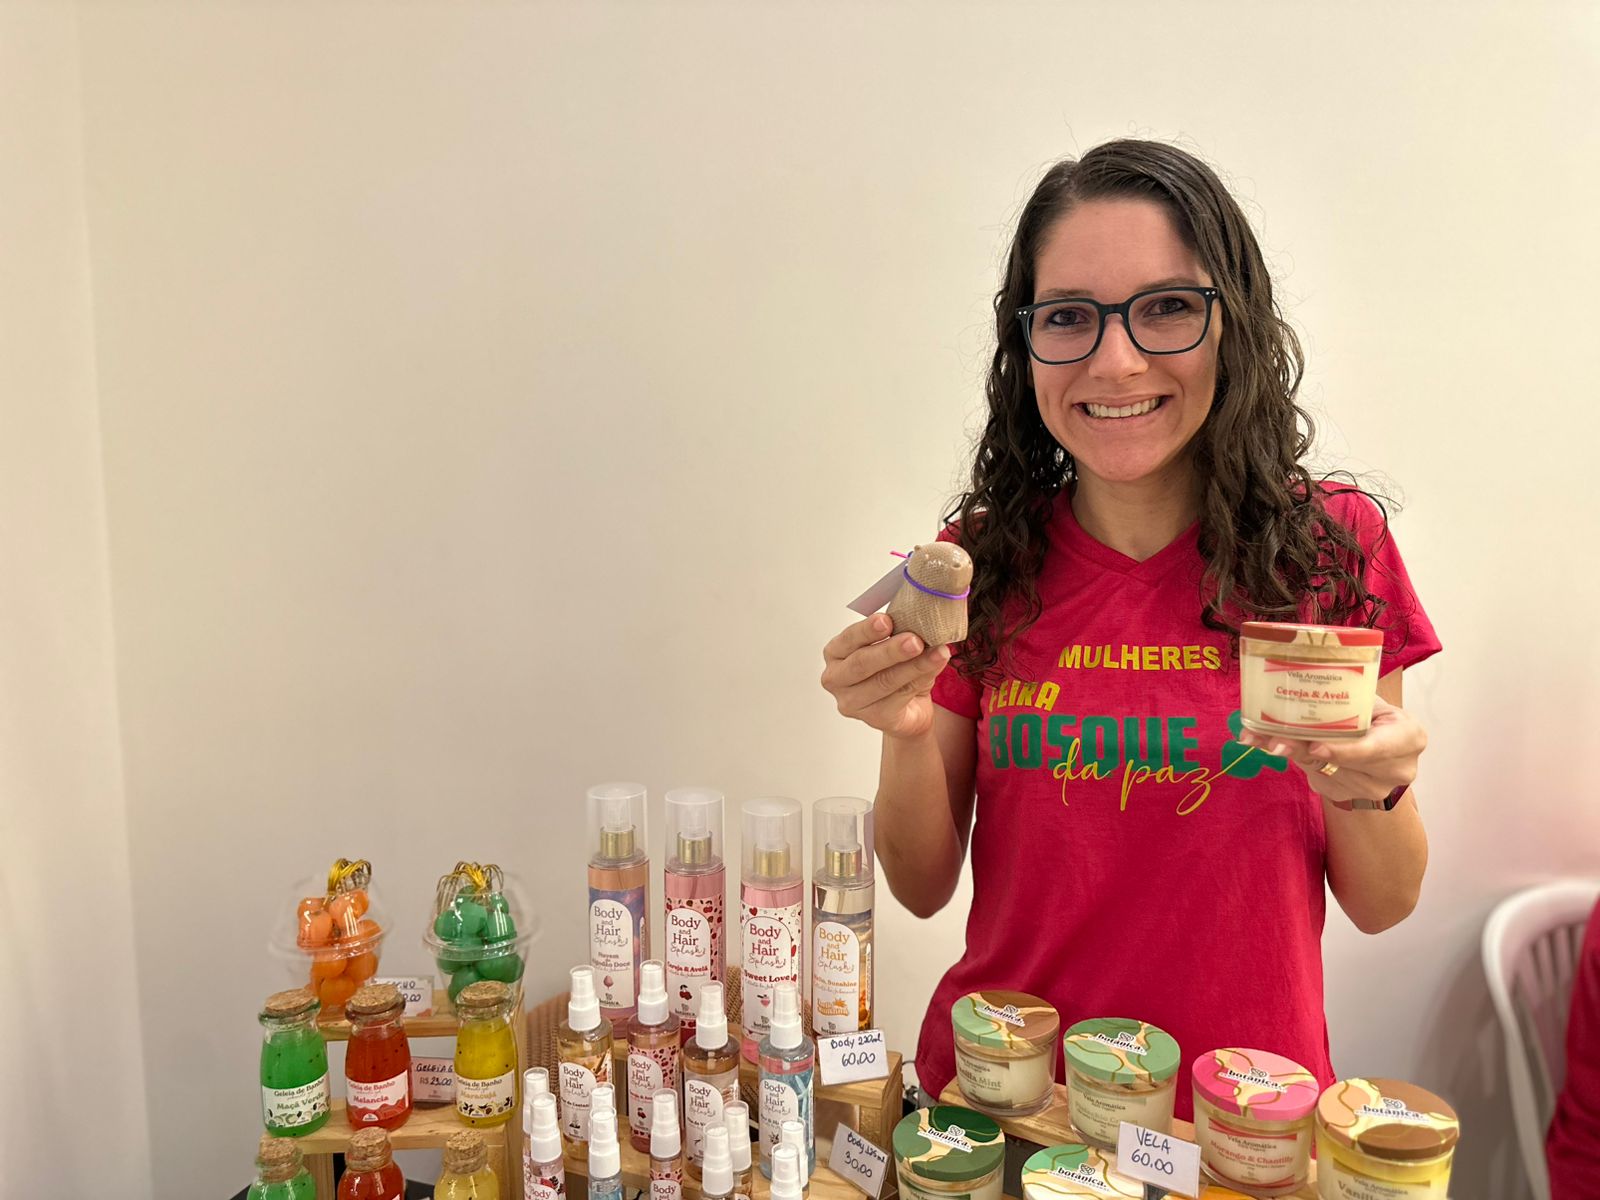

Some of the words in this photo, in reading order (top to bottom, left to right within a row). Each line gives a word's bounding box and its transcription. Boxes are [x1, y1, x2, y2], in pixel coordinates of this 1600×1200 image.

[1058, 644, 1222, 671] MULHERES
[1276, 686, 1309, 698] Cereja
[1311, 690, 1320, 698] &
[989, 712, 1200, 775] BOSQUE
[1053, 738, 1111, 806] da
[1120, 747, 1252, 815] paz
[594, 905, 623, 920] Body
[671, 915, 701, 930] Body
[596, 924, 620, 936] Hair
[749, 923, 781, 939] Body
[819, 927, 850, 945] Body
[673, 933, 698, 946] Hair
[752, 943, 779, 956] Hair
[821, 947, 847, 961] Hair
[769, 974, 790, 982] Love
[631, 1058, 651, 1071] Body
[563, 1066, 585, 1078] Body
[632, 1070, 650, 1082] Hair
[565, 1079, 583, 1089] Hair
[689, 1084, 711, 1097] Body
[764, 1081, 786, 1094] Body
[690, 1097, 710, 1109] Hair
[765, 1095, 784, 1106] Hair
[1136, 1127, 1171, 1154] VELA
[653, 1184, 676, 1195] Body
